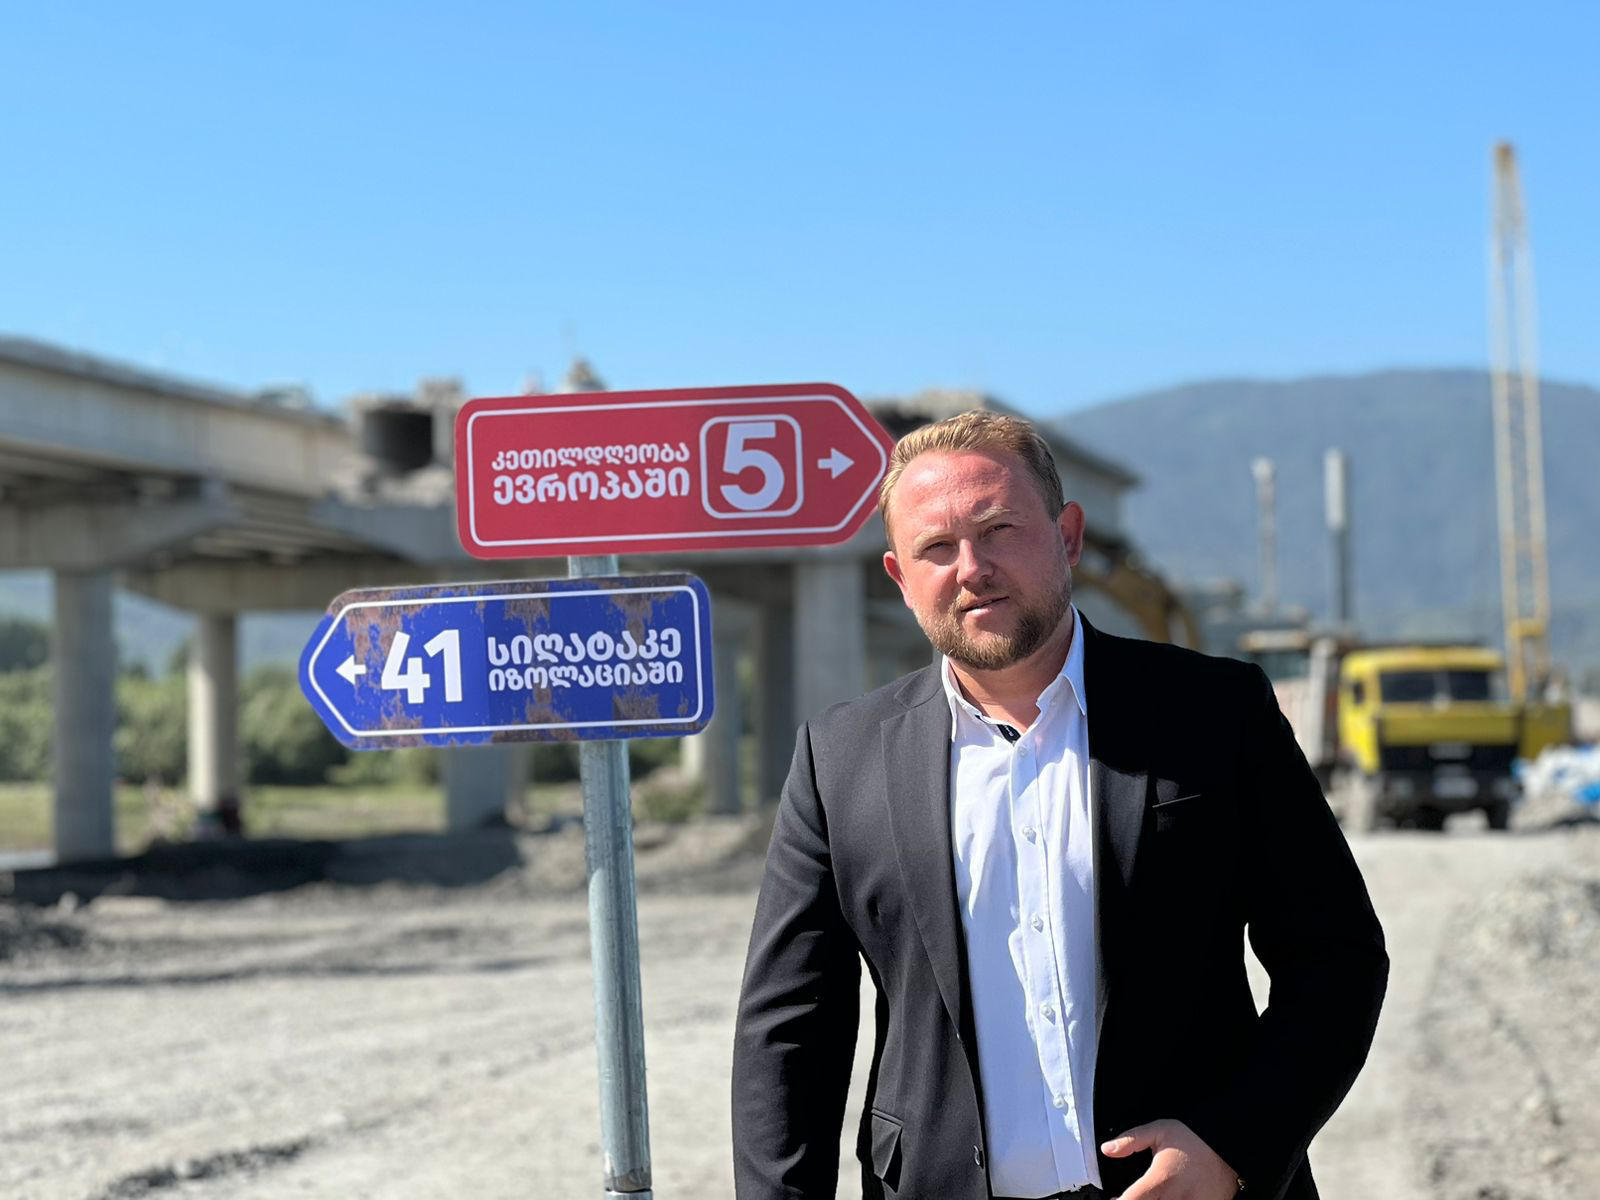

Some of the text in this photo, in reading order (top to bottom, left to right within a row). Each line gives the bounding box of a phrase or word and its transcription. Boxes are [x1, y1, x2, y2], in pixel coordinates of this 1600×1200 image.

[491, 442, 690, 471] კეთილდღეობა
[720, 422, 785, 511] 5
[493, 466, 690, 505] ევროპაში
[487, 628, 682, 666] სიღატაკე
[380, 629, 463, 704] 41
[488, 660, 684, 691] იზოლაციაში
